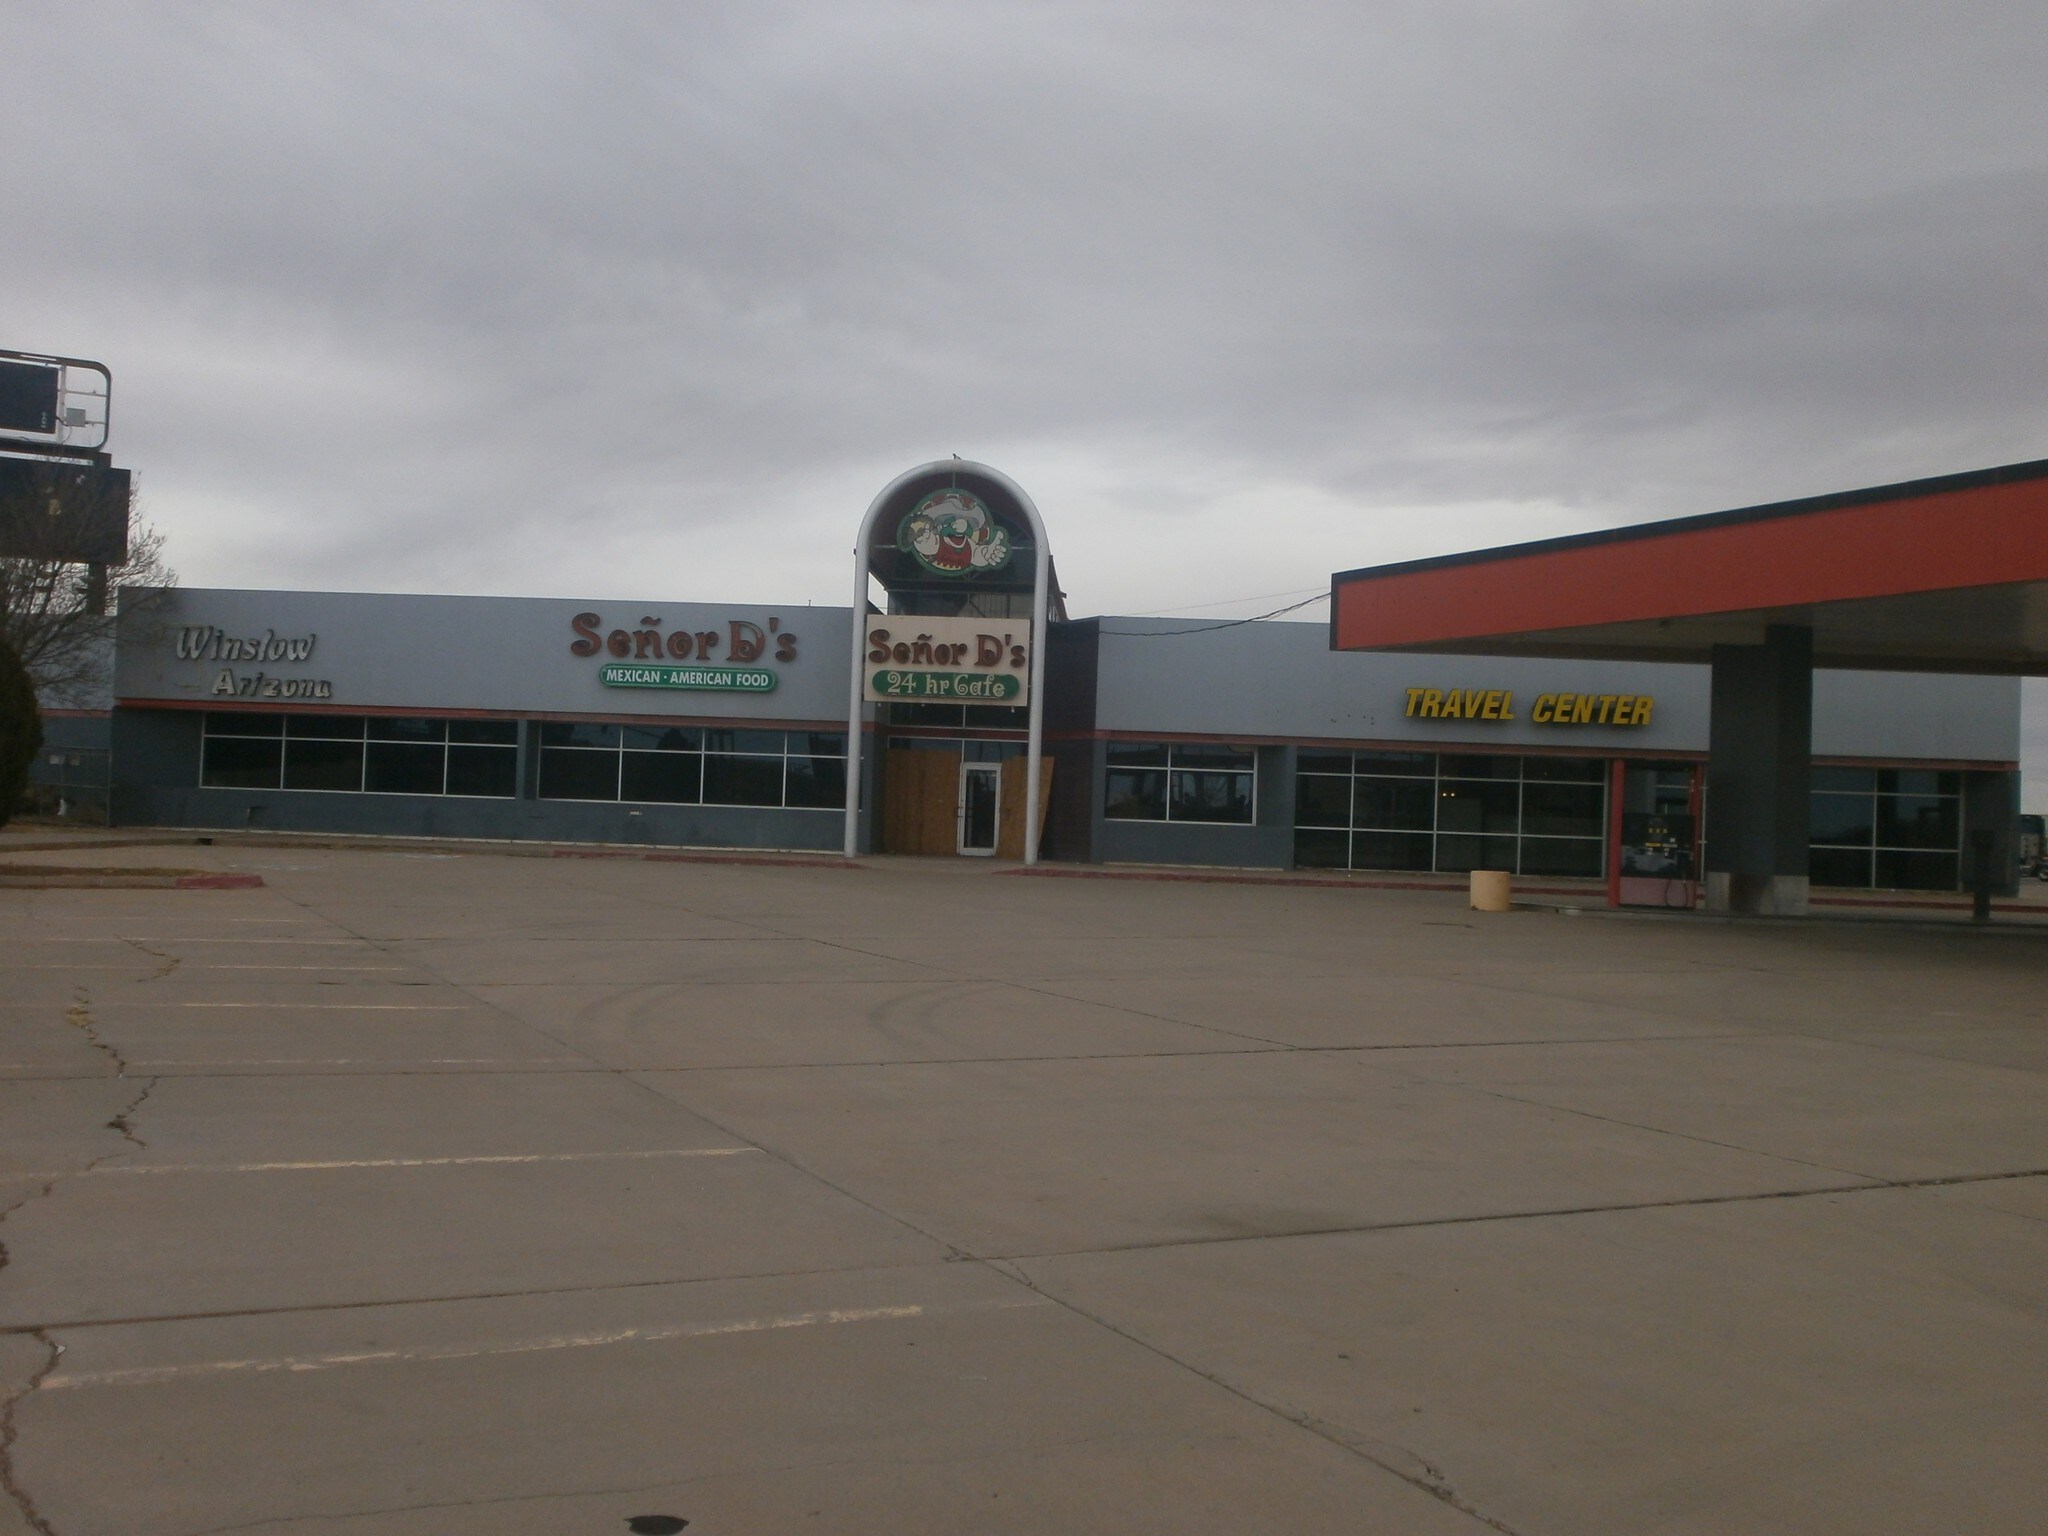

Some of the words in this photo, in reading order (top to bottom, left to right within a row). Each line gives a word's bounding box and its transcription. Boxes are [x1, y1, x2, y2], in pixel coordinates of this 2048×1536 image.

[176, 625, 316, 661] Winslow
[570, 612, 719, 660] Señor
[726, 617, 797, 662] D's
[868, 629, 968, 666] Señor
[974, 633, 1025, 667] D's
[211, 668, 332, 698] Arizona
[606, 669, 660, 683] MEXICAN
[669, 671, 731, 686] AMERICAN
[736, 673, 769, 687] FOOD
[887, 672, 916, 693] 24
[925, 674, 950, 695] hr
[954, 674, 1005, 697] Cafe
[1404, 688, 1515, 720] TRAVEL
[1532, 693, 1654, 725] CENTER
